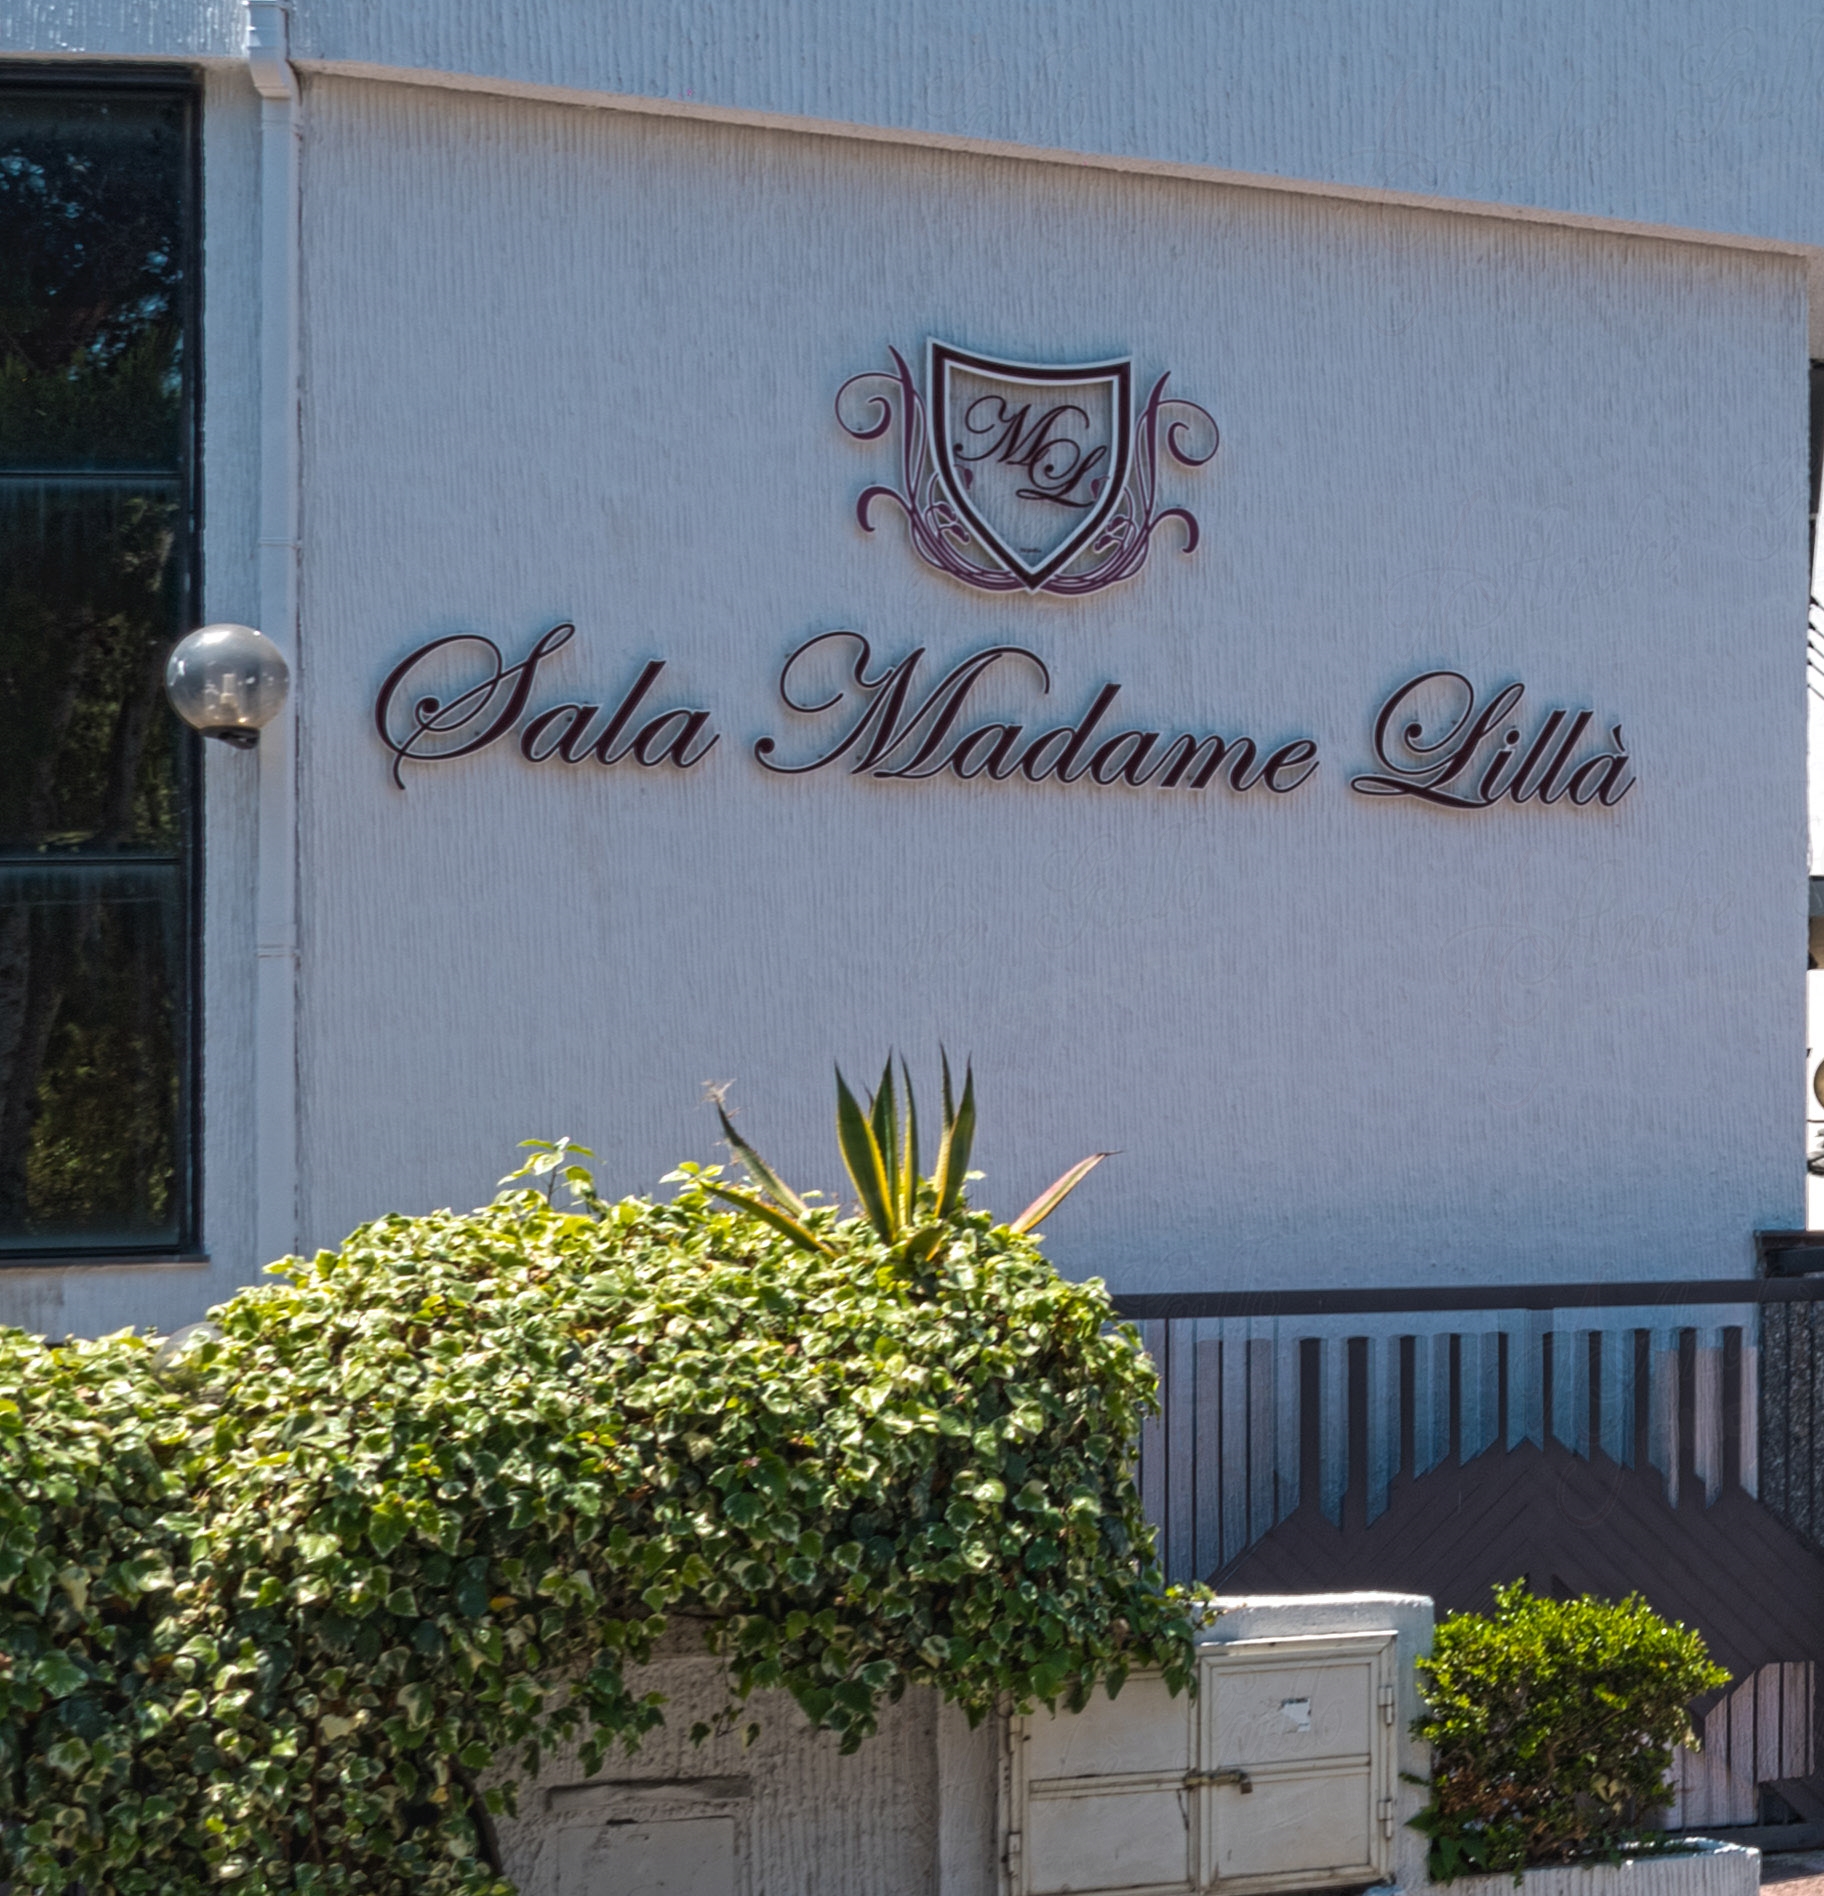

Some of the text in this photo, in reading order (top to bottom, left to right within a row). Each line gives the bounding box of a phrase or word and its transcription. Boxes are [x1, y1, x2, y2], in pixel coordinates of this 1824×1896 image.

[374, 622, 1638, 810] Sala Madame Lillà
